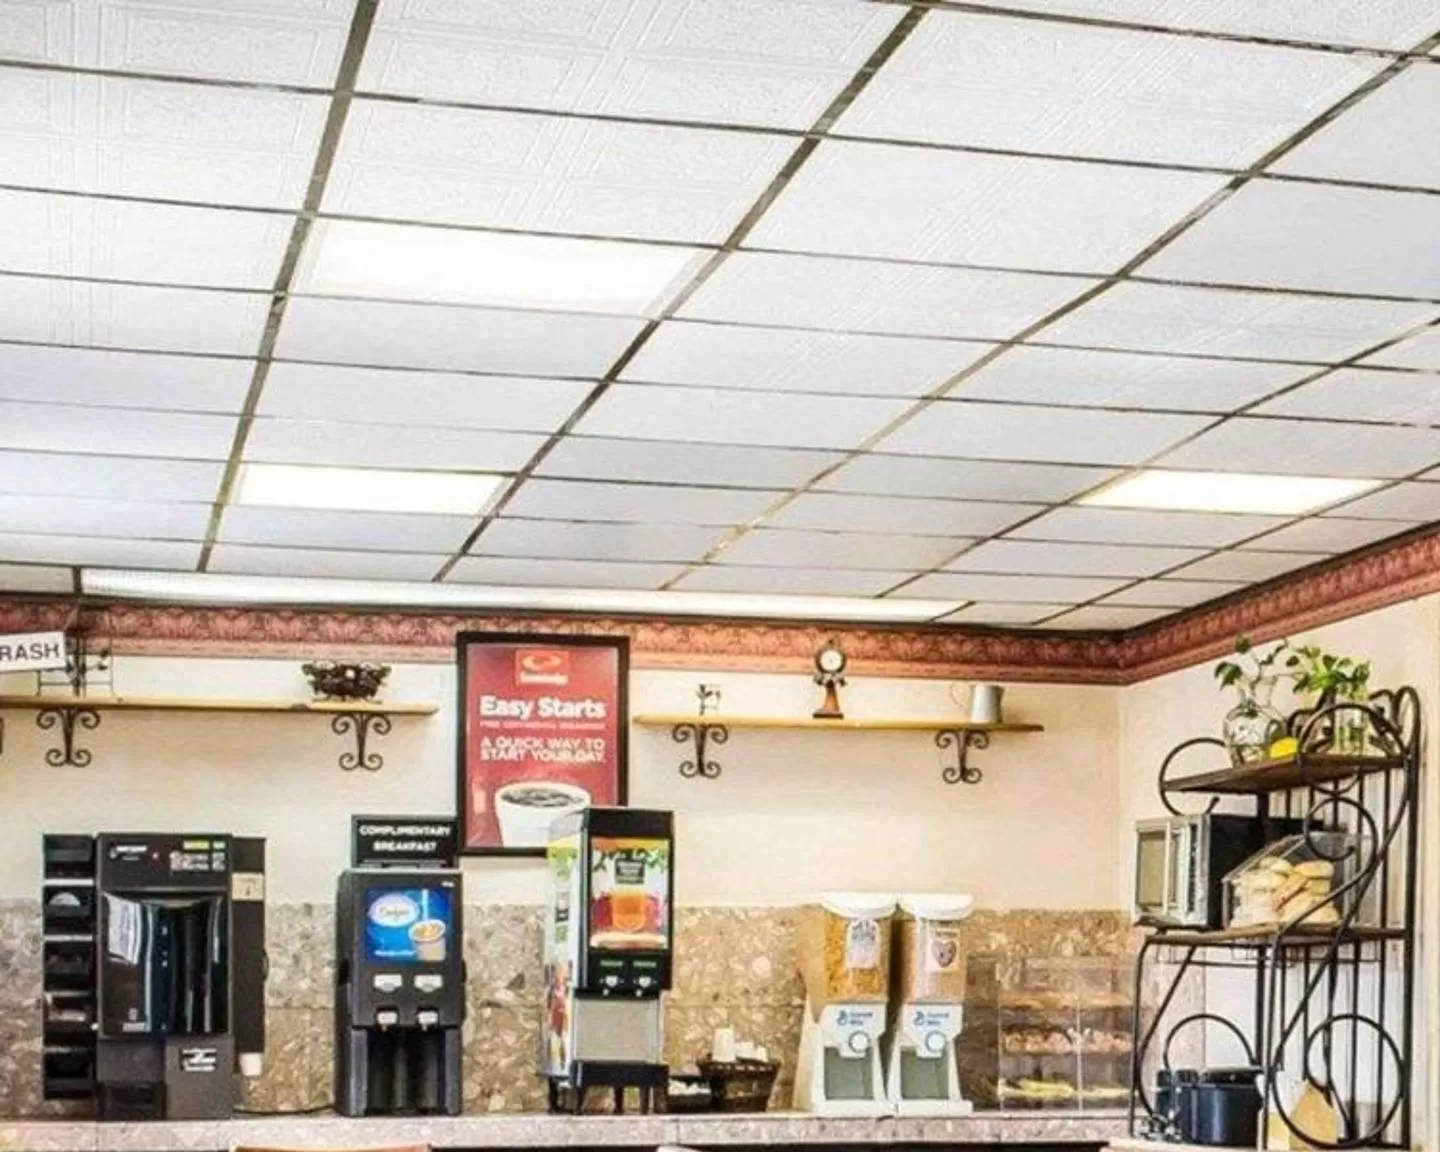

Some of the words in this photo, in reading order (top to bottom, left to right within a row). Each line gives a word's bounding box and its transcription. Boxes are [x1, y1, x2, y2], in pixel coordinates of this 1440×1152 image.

[479, 696, 533, 720] Easy
[537, 696, 606, 718] Starts
[480, 737, 492, 748] A
[495, 736, 543, 750] QUICK
[547, 737, 582, 750] WAY
[586, 738, 606, 751] TO
[480, 749, 525, 761] START
[359, 825, 451, 837] COMPLIMENTARY
[373, 841, 437, 852] BREAKFAST
